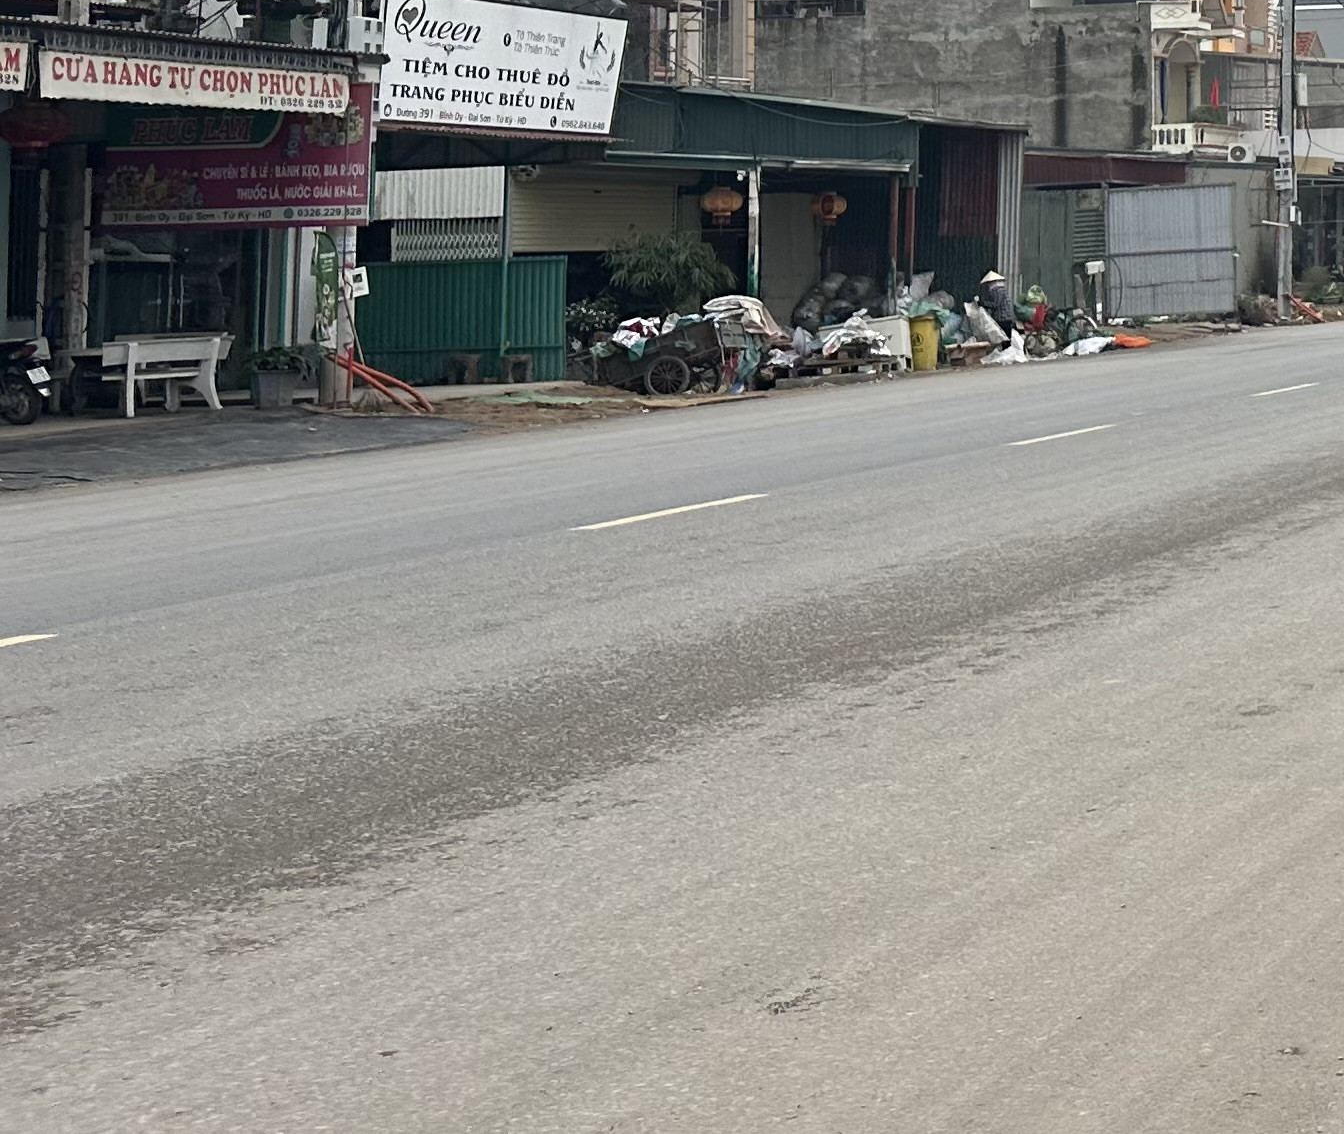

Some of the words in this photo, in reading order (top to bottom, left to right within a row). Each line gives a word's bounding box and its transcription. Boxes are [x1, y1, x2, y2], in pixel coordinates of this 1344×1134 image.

[168, 65, 196, 95] TỰ
[200, 69, 253, 98] CHỌN
[402, 56, 448, 78] TIỆM
[454, 64, 490, 81] CHO
[496, 68, 542, 85] THUÊ
[547, 67, 570, 87] ĐỒ
[390, 84, 445, 102] TRANG
[451, 89, 495, 107] PHỤC
[499, 87, 535, 108] BIỂU
[540, 92, 575, 111] DIỄN
[419, 107, 434, 120] 391
